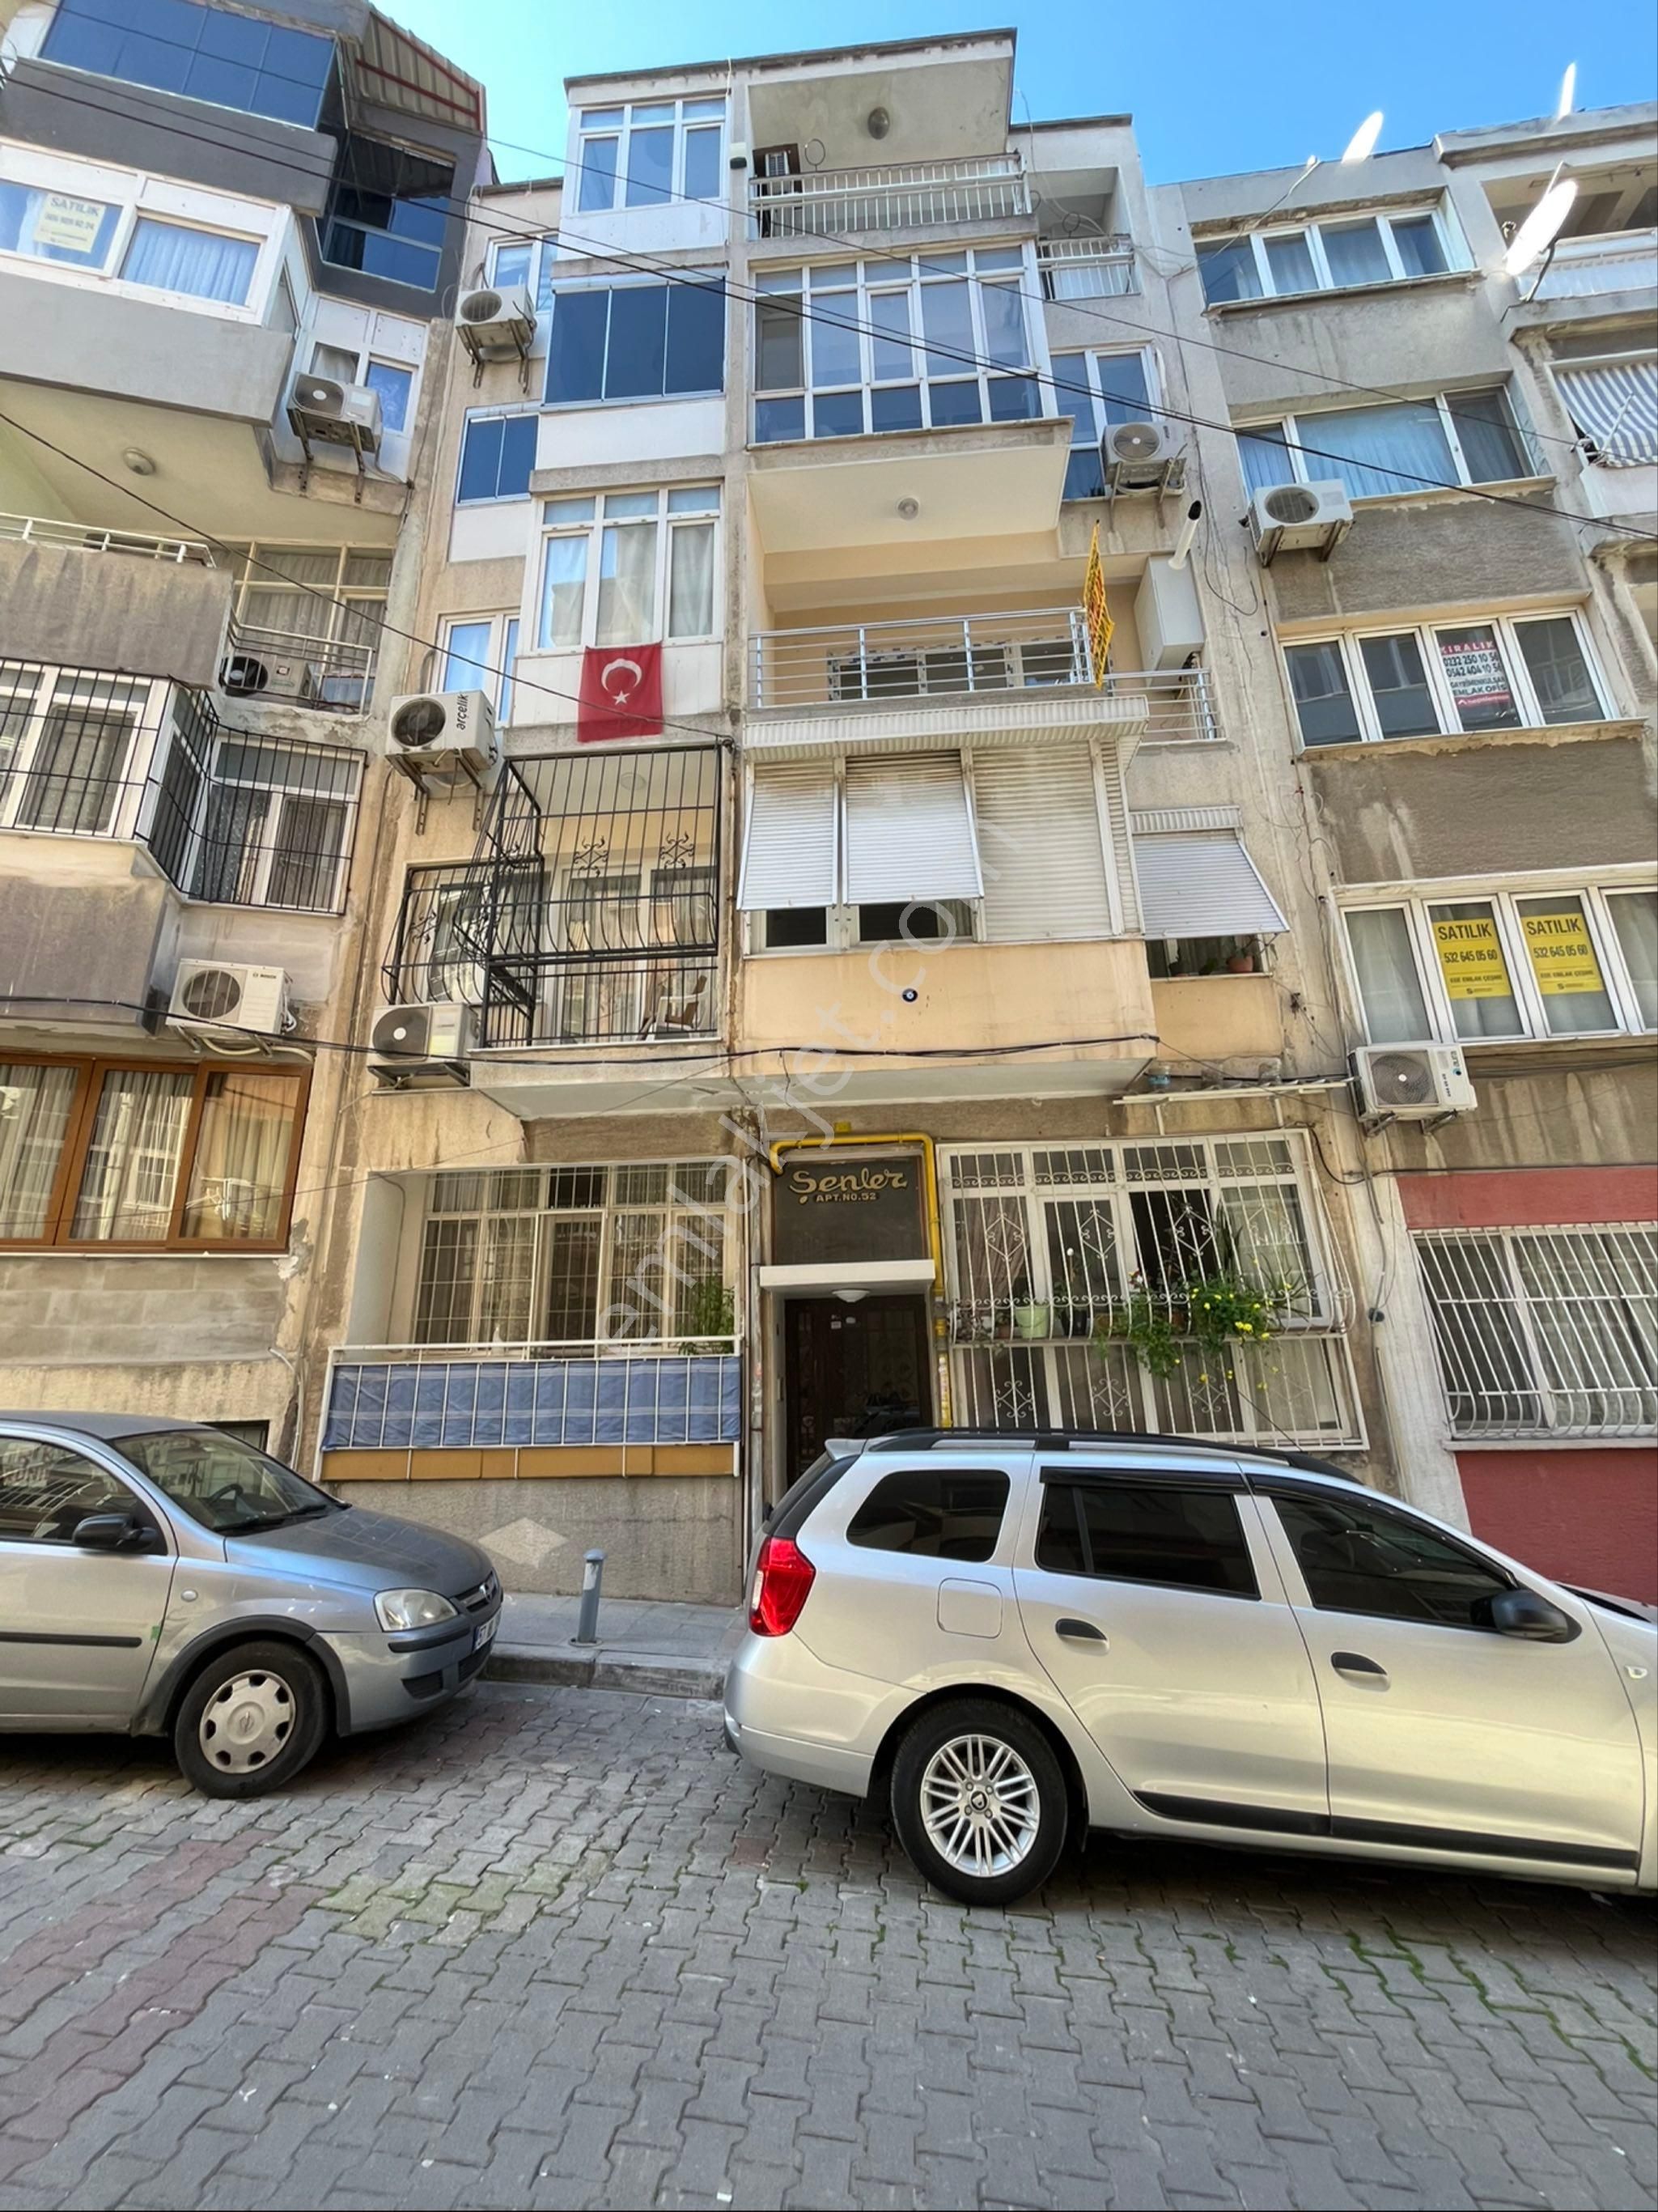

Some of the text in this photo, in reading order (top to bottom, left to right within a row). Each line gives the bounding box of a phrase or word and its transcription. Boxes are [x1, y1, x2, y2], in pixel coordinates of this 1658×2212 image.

[1443, 655, 1462, 667] 0232
[1462, 653, 1478, 664] 250
[1478, 652, 1489, 663] 10
[1446, 666, 1466, 677] 0542
[1466, 664, 1482, 676] 404
[1482, 664, 1492, 674] 10
[1452, 685, 1484, 695] EMLAK
[1438, 923, 1492, 940] SATILIK
[1526, 918, 1582, 936] SATILIK
[1444, 949, 1499, 963] 532 645 05 60
[1533, 944, 1588, 959] 532 645 05 60
